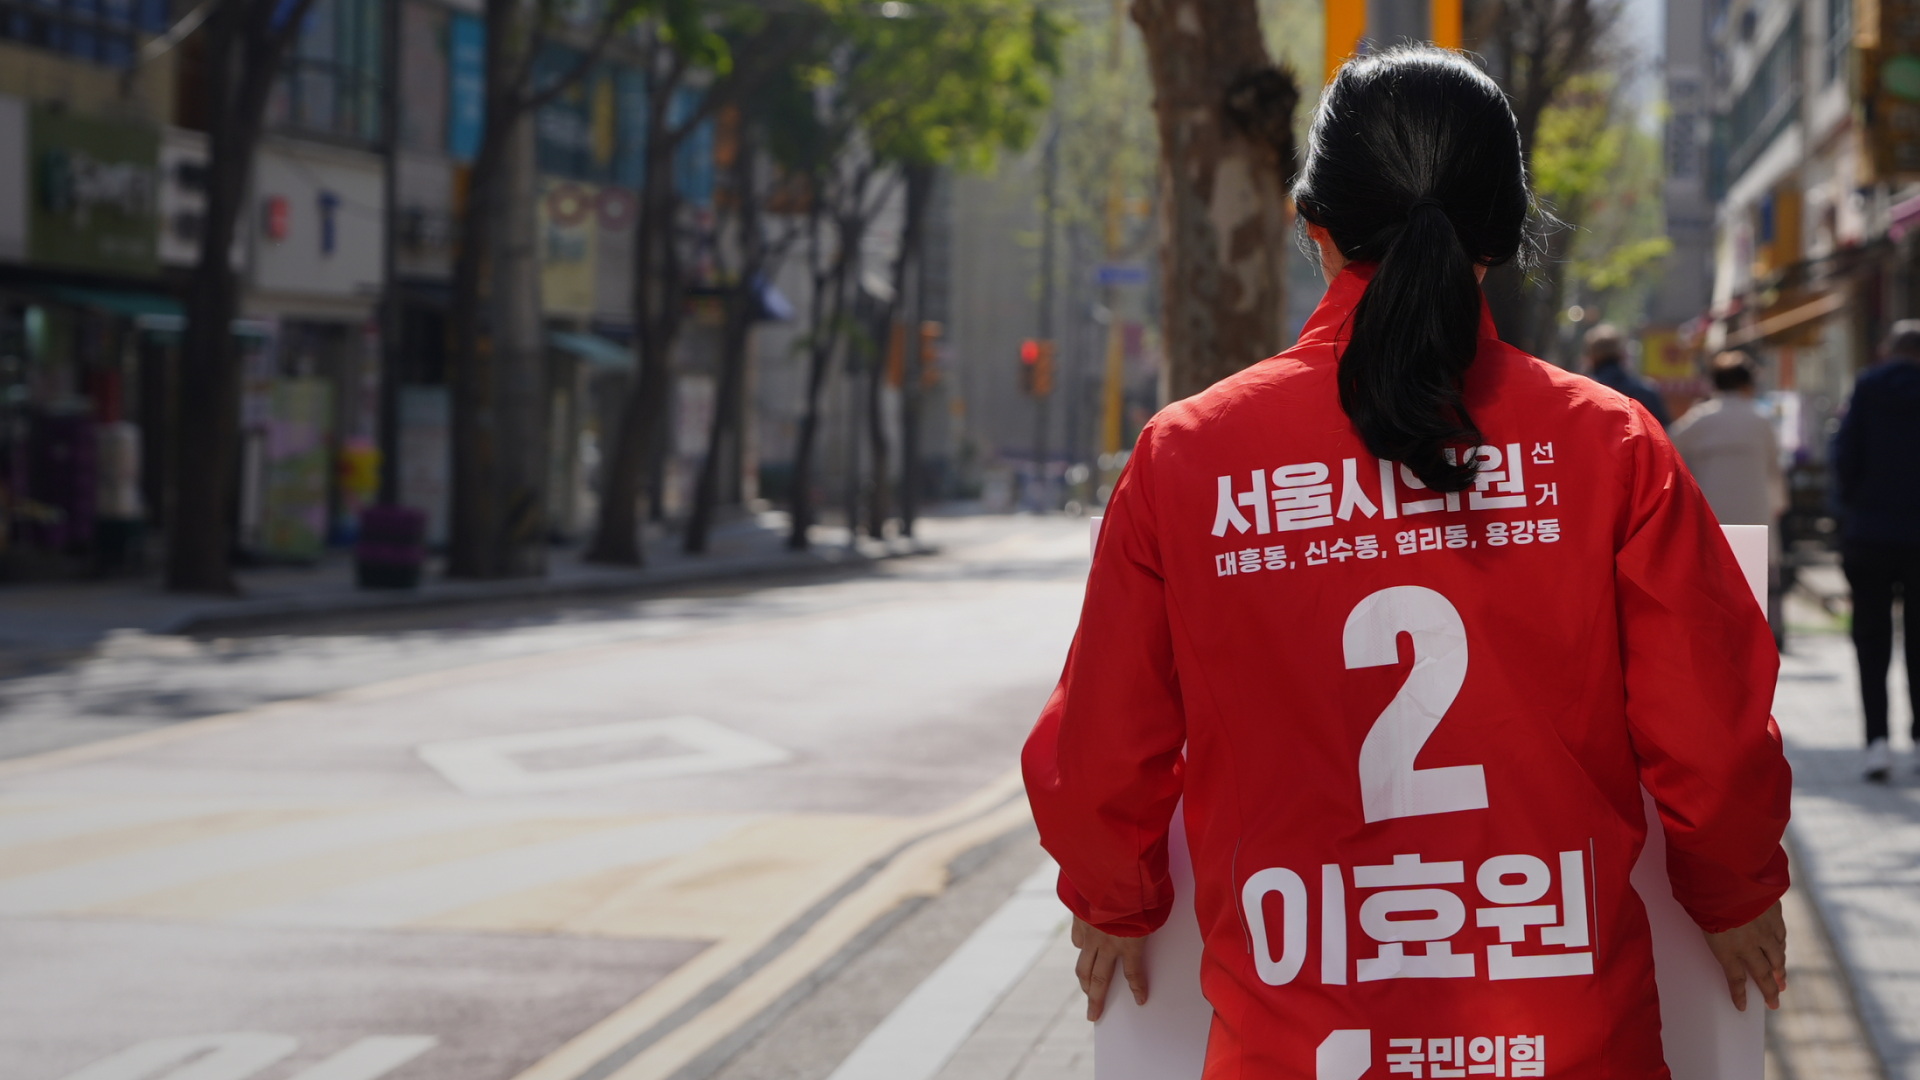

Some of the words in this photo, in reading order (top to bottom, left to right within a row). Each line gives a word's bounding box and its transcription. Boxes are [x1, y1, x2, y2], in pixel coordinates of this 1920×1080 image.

[1531, 442, 1559, 506] 선거
[1215, 545, 1296, 577] 대흥동,
[1304, 535, 1387, 566] 신수동,
[1395, 524, 1477, 556] 염리동,
[1485, 518, 1561, 547] 용강동
[1342, 585, 1489, 824] 2
[1240, 850, 1594, 986] 이효원
[1386, 1035, 1545, 1079] 국민의힘
